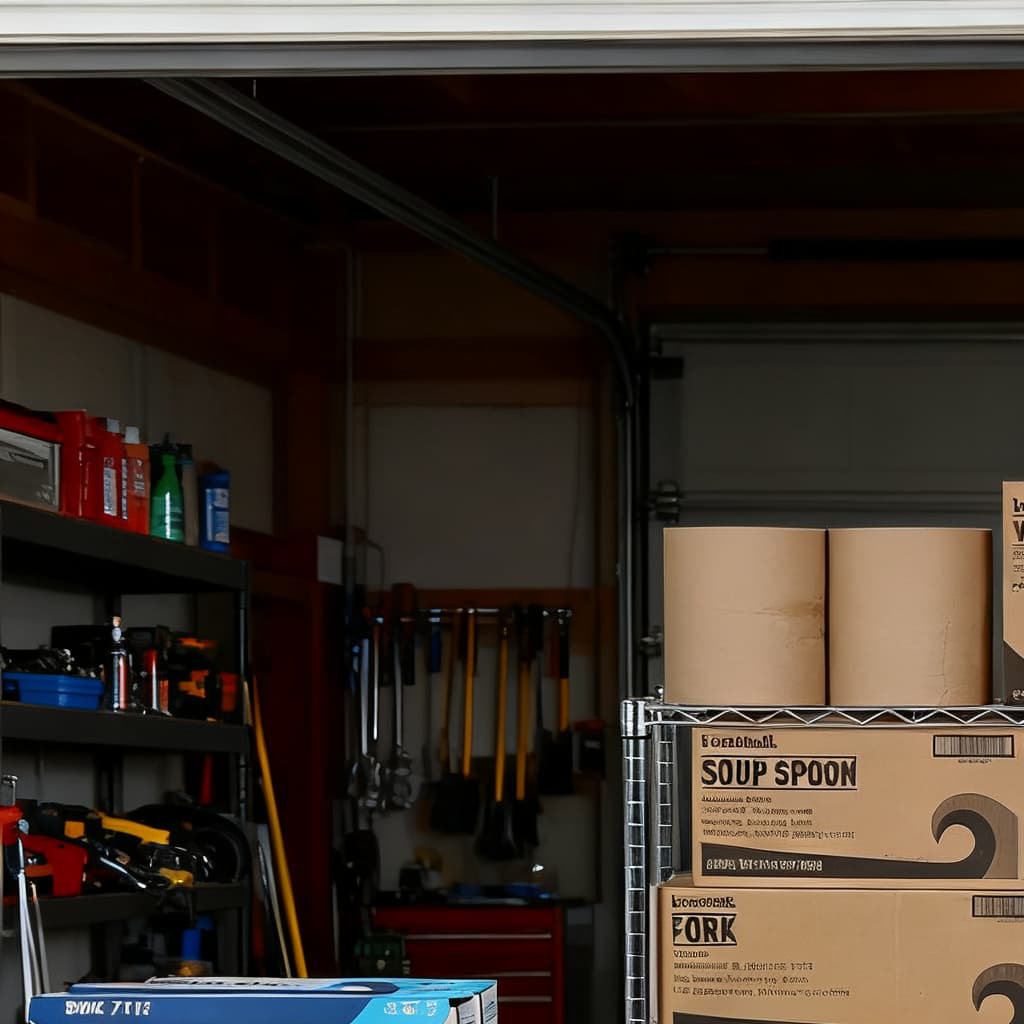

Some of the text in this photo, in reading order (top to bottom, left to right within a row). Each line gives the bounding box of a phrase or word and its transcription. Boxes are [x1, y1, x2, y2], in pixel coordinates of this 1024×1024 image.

[701, 757, 857, 786] SOUP SPOON
[672, 916, 737, 943] FORK
